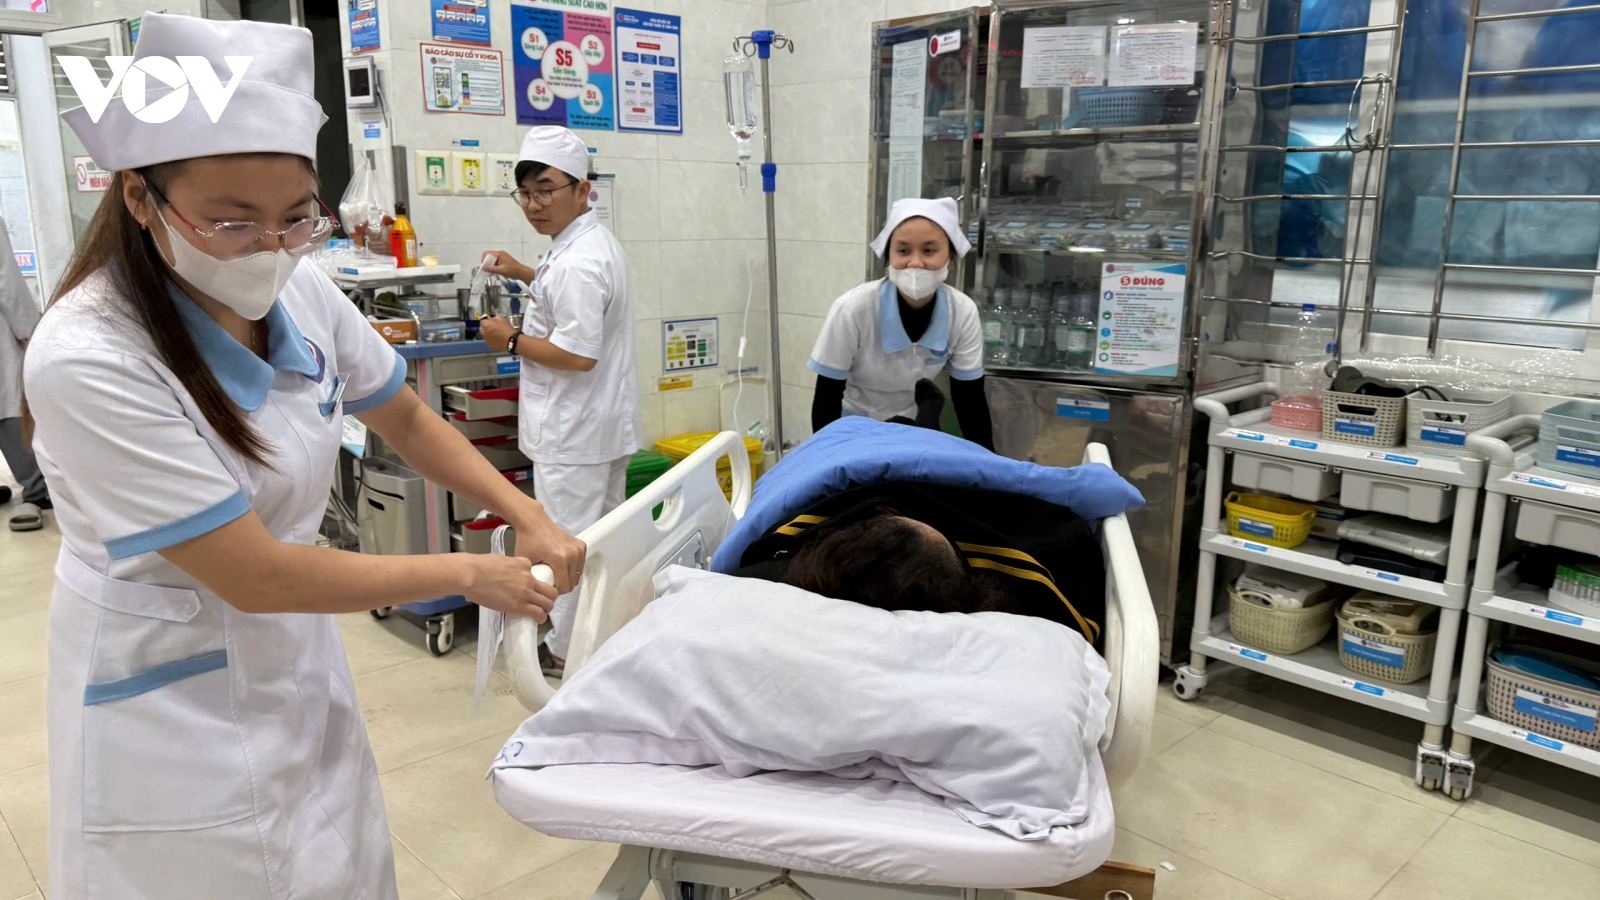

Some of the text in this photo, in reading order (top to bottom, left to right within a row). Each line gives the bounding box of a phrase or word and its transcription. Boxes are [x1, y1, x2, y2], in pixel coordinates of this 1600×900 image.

[583, 0, 595, 9] CAO
[529, 33, 539, 43] S1
[588, 40, 598, 50] S2
[480, 53, 498, 61] KHOA
[555, 48, 573, 67] S5
[535, 85, 546, 95] S4
[586, 90, 597, 99] S3
[1121, 275, 1165, 286] 5 ĐÚNG
